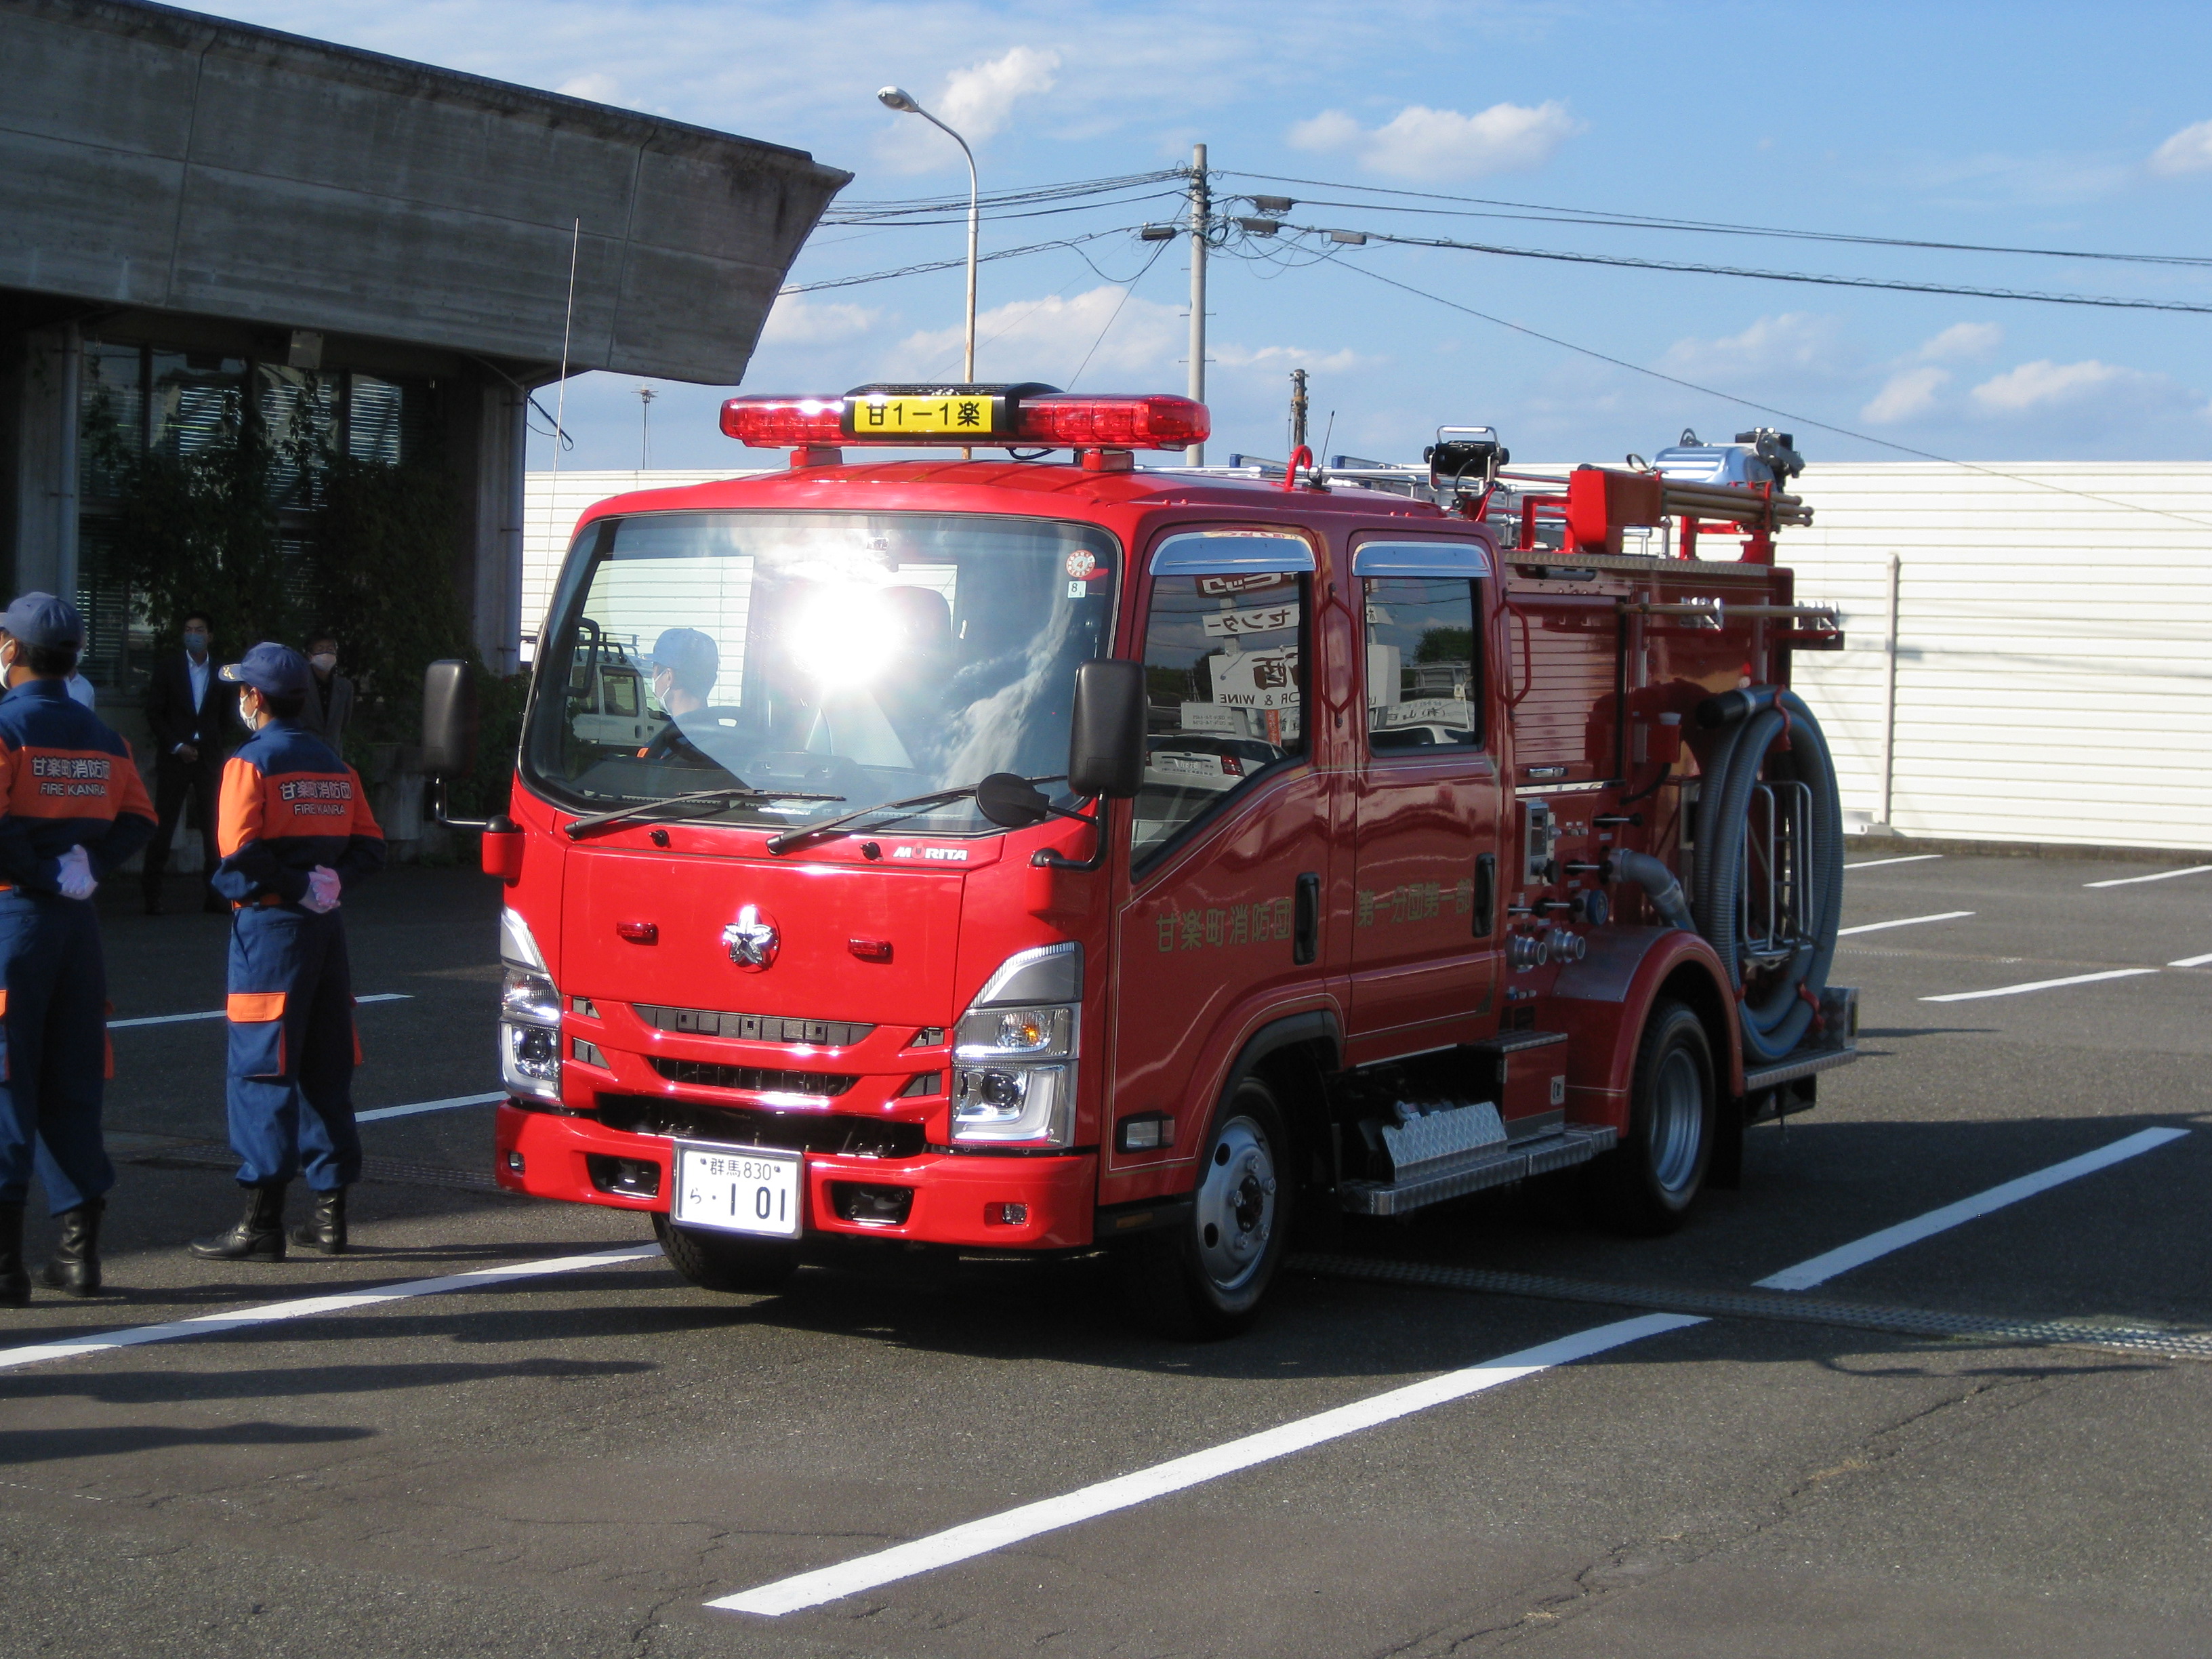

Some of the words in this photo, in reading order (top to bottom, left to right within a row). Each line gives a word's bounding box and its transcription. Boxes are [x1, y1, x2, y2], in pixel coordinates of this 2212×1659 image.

[1076, 560, 1084, 569] 4
[1071, 582, 1078, 592] 8
[40, 783, 64, 796] FIRE
[68, 784, 106, 796] KANRA
[279, 780, 352, 800] 甘楽町消防団
[294, 804, 315, 815] FIRE
[316, 804, 346, 815] KANRA
[893, 842, 968, 861] MORITA
[1357, 880, 1471, 927] 第一分団第一部
[1155, 899, 1292, 952] 甘楽町消防団
